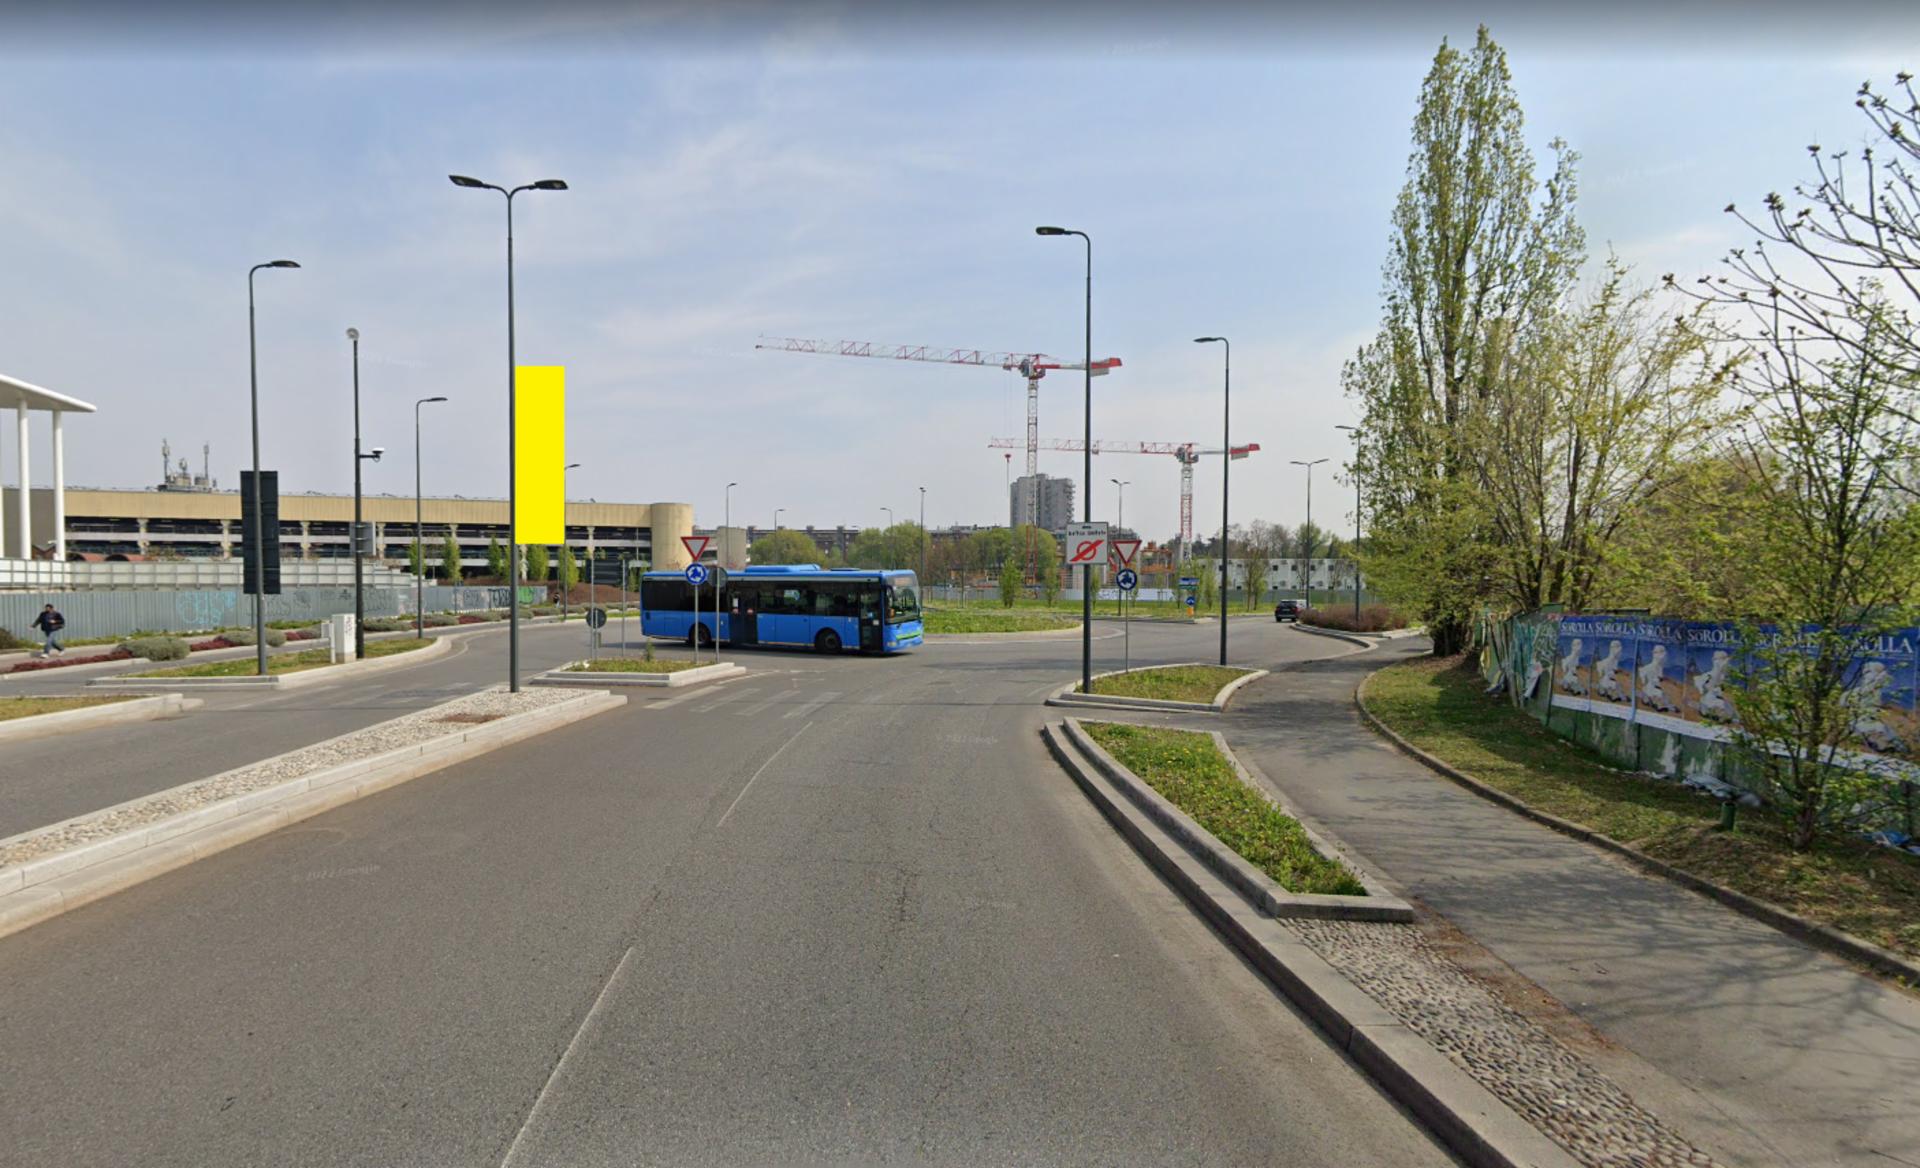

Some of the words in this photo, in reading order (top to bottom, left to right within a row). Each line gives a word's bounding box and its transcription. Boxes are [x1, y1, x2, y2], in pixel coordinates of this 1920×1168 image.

[1639, 623, 1683, 641] SROLA
[1687, 628, 1747, 643] SOROLL
[1846, 635, 1914, 654] ROLLA
